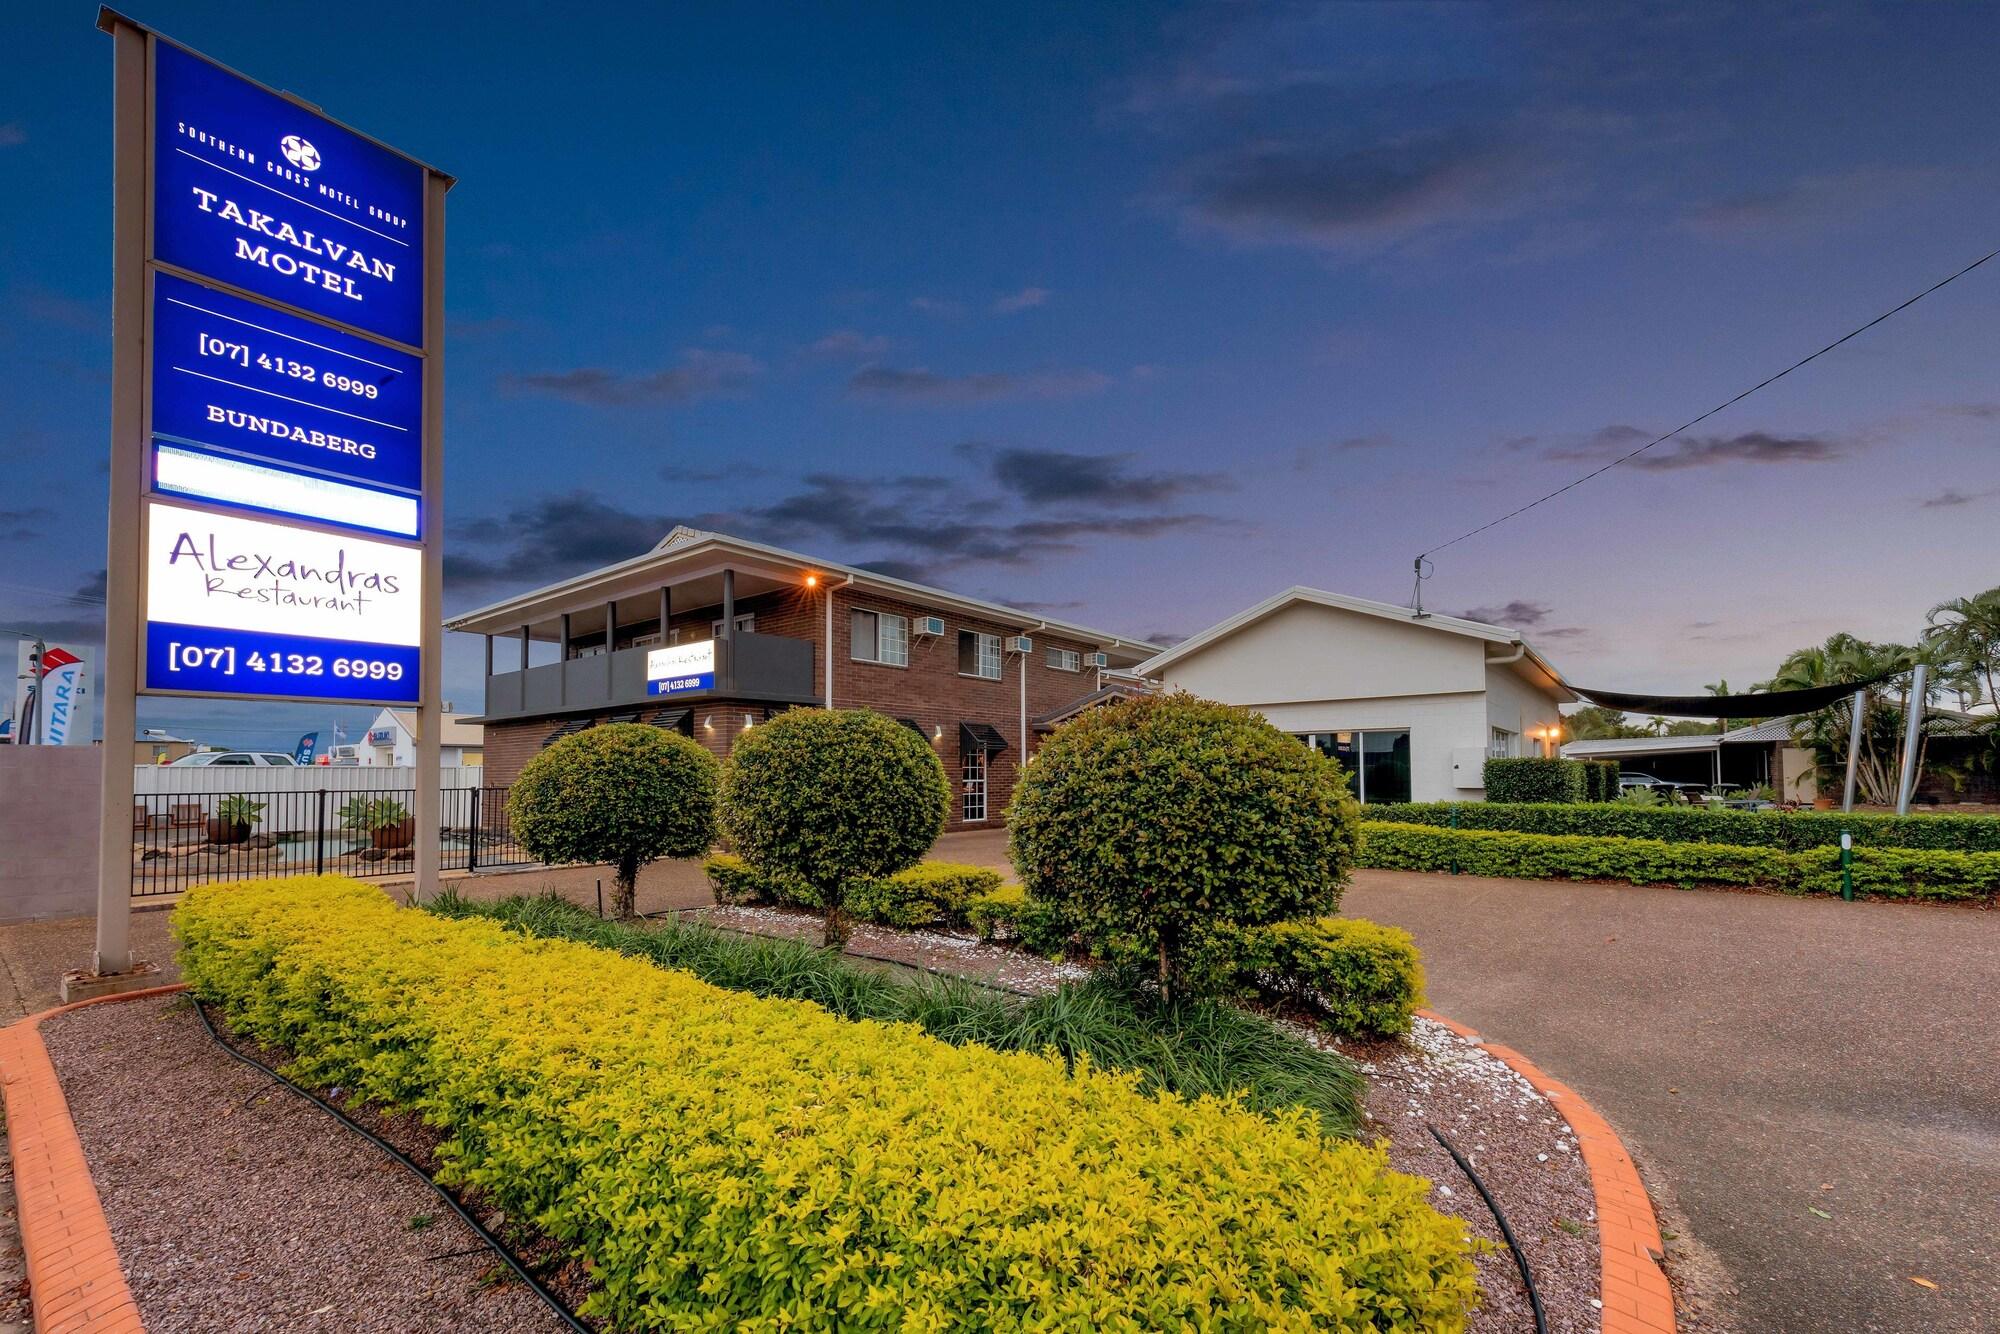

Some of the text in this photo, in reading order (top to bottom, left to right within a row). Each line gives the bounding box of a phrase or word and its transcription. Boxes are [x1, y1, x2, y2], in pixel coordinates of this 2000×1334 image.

[178, 122, 407, 229] SOUTHERN CROSS MOTEL GROUP
[192, 186, 396, 282] TAKALVAN
[235, 237, 363, 301] MOTEL
[199, 332, 378, 399] [07] 4132 6999
[206, 404, 377, 459] BUNDABERG
[169, 532, 400, 594] Alexandras
[205, 573, 372, 615] Restaurant
[169, 642, 403, 681] [07] 4132 6999
[658, 678, 700, 693] [07] 4132 6999
